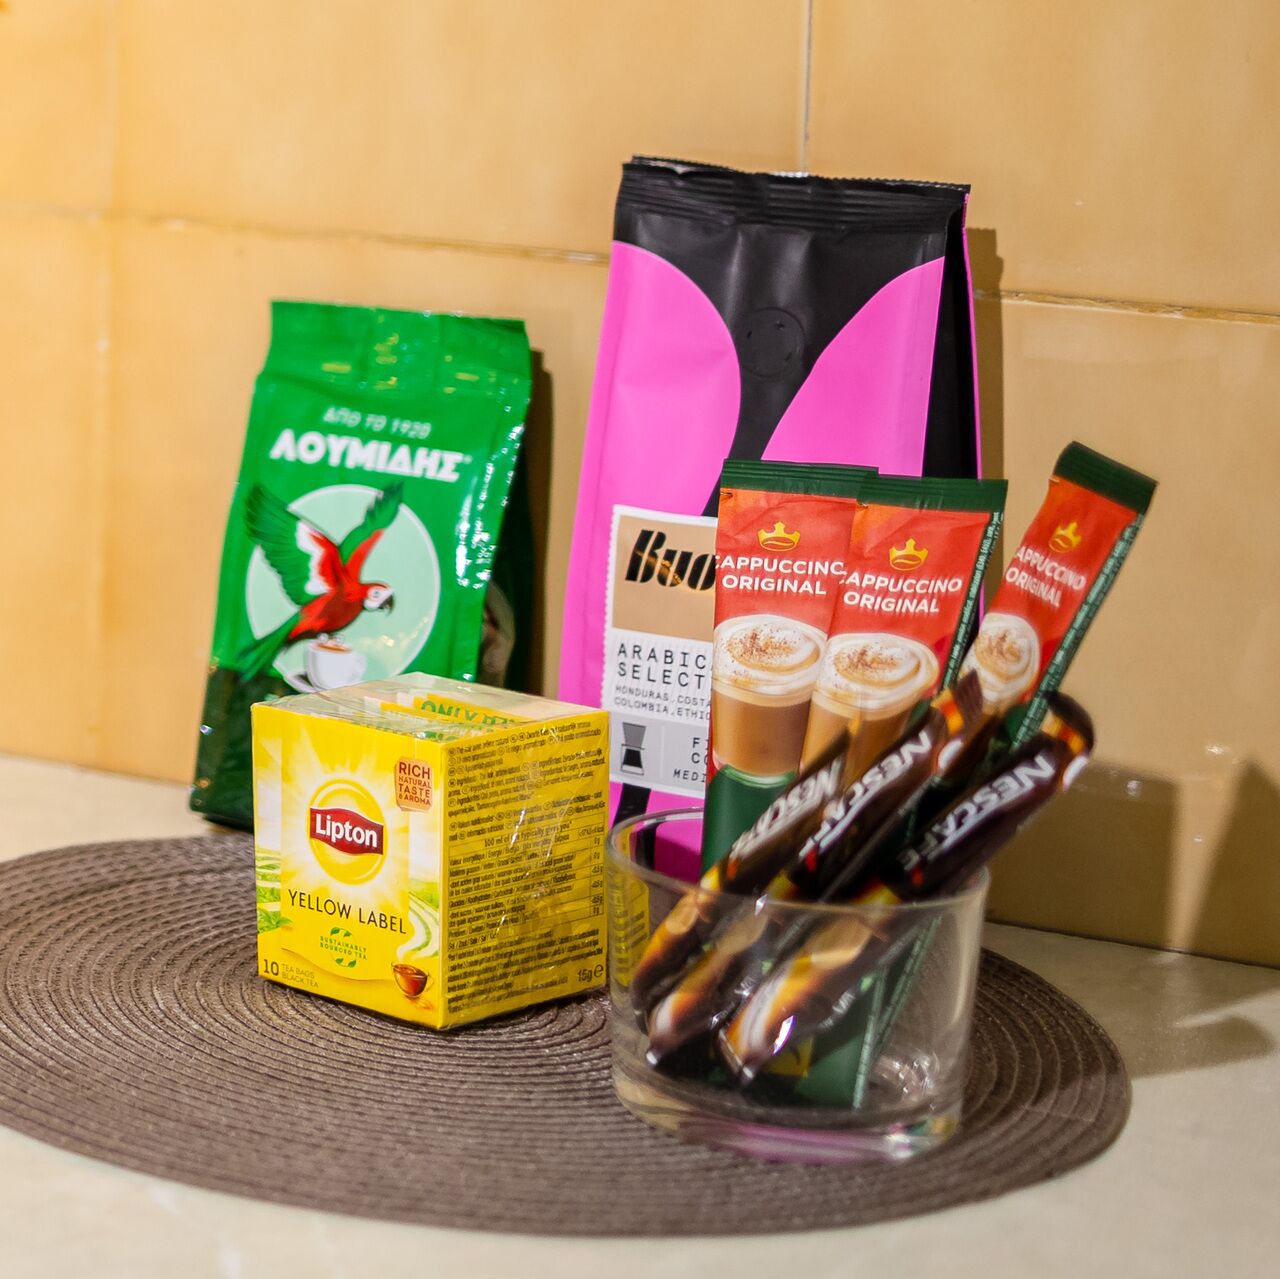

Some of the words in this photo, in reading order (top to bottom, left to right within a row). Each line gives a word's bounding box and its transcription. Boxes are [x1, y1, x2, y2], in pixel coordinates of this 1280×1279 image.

[269, 428, 464, 483] ΛΟΥΜΙΔΗΣ
[722, 574, 827, 595] ORIGINAL
[839, 572, 962, 594] APPUCCINO
[1006, 567, 1062, 608] ORIGINAL
[843, 592, 939, 613] ORIGINAL
[618, 662, 705, 689] SELECT
[399, 762, 430, 779] RICH
[398, 776, 431, 789] NATURAL
[398, 783, 430, 799] TASTE
[404, 794, 431, 806] AROMA
[315, 814, 378, 848] Lipton
[288, 889, 352, 919] YELLOW
[359, 907, 406, 934] LABEL
[263, 959, 279, 976] 10
[282, 963, 294, 973] TEA
[296, 967, 315, 979] BAGS
[577, 969, 593, 982] 15g
[282, 972, 306, 984] BLACK
[307, 979, 319, 988] TEA
